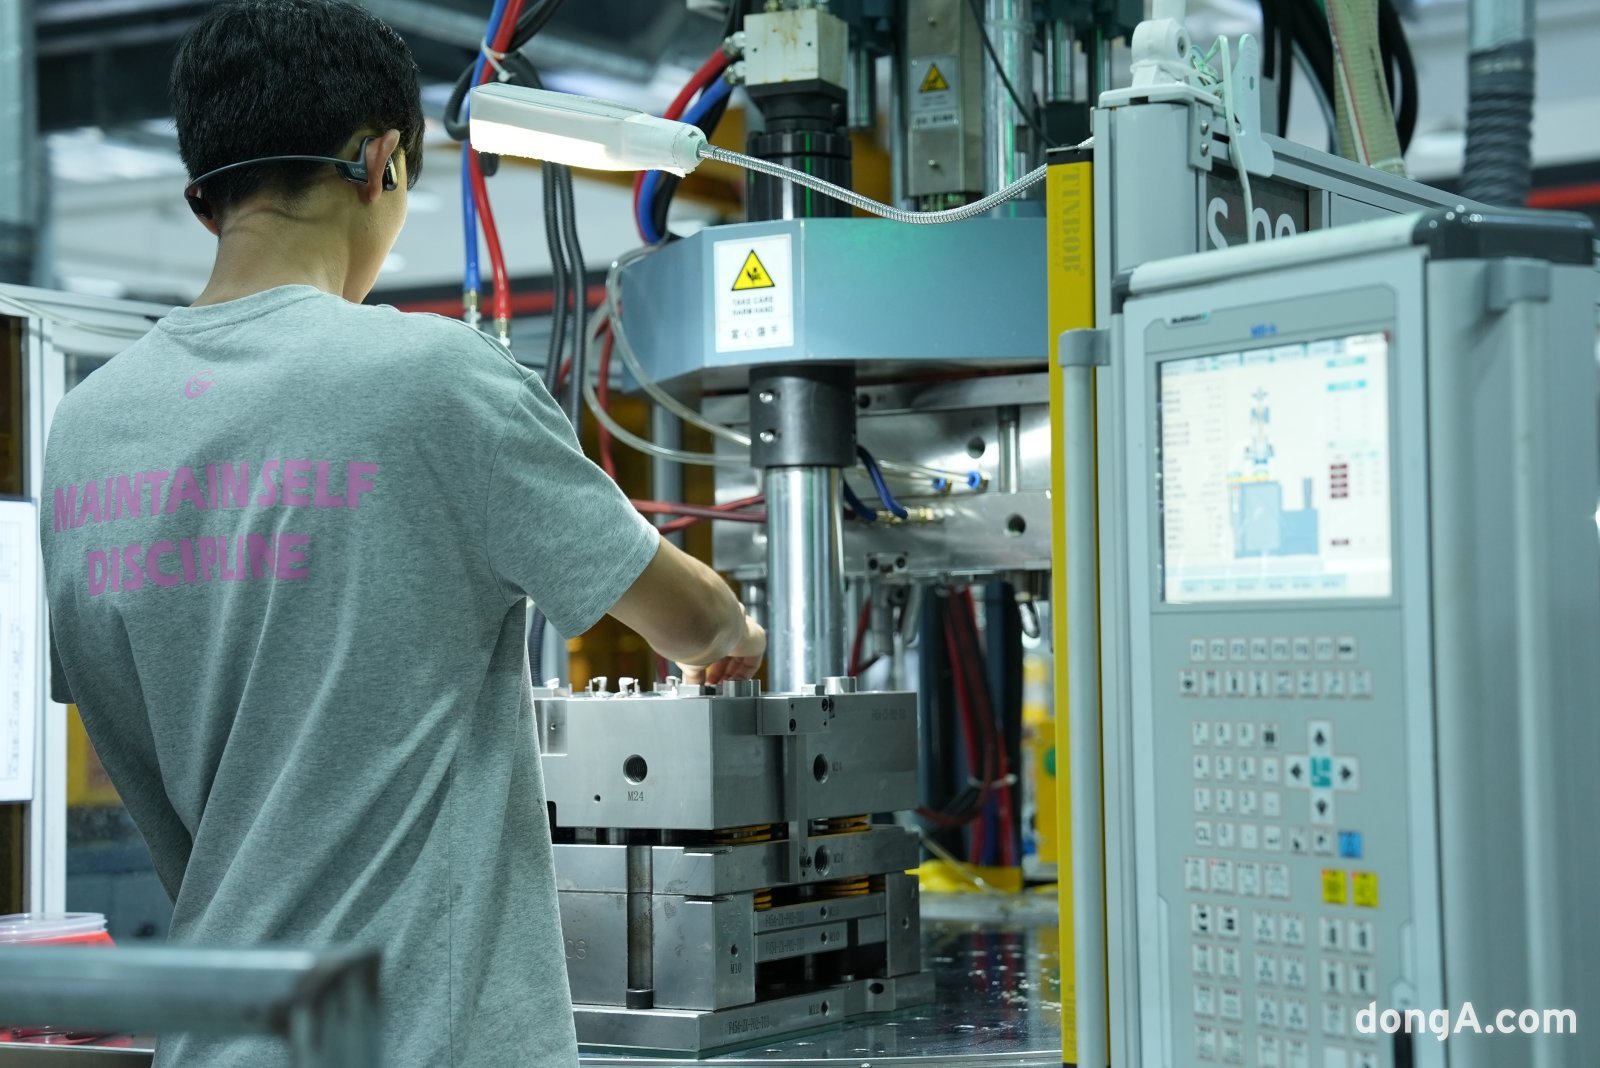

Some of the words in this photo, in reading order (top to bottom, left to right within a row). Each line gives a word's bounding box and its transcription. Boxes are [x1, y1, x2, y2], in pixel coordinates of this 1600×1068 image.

[54, 461, 250, 533] MAINTAIN
[257, 459, 378, 509] SELF
[87, 533, 311, 597] DISCIPLINE
[627, 790, 644, 801] M24
[730, 962, 742, 975] M10
